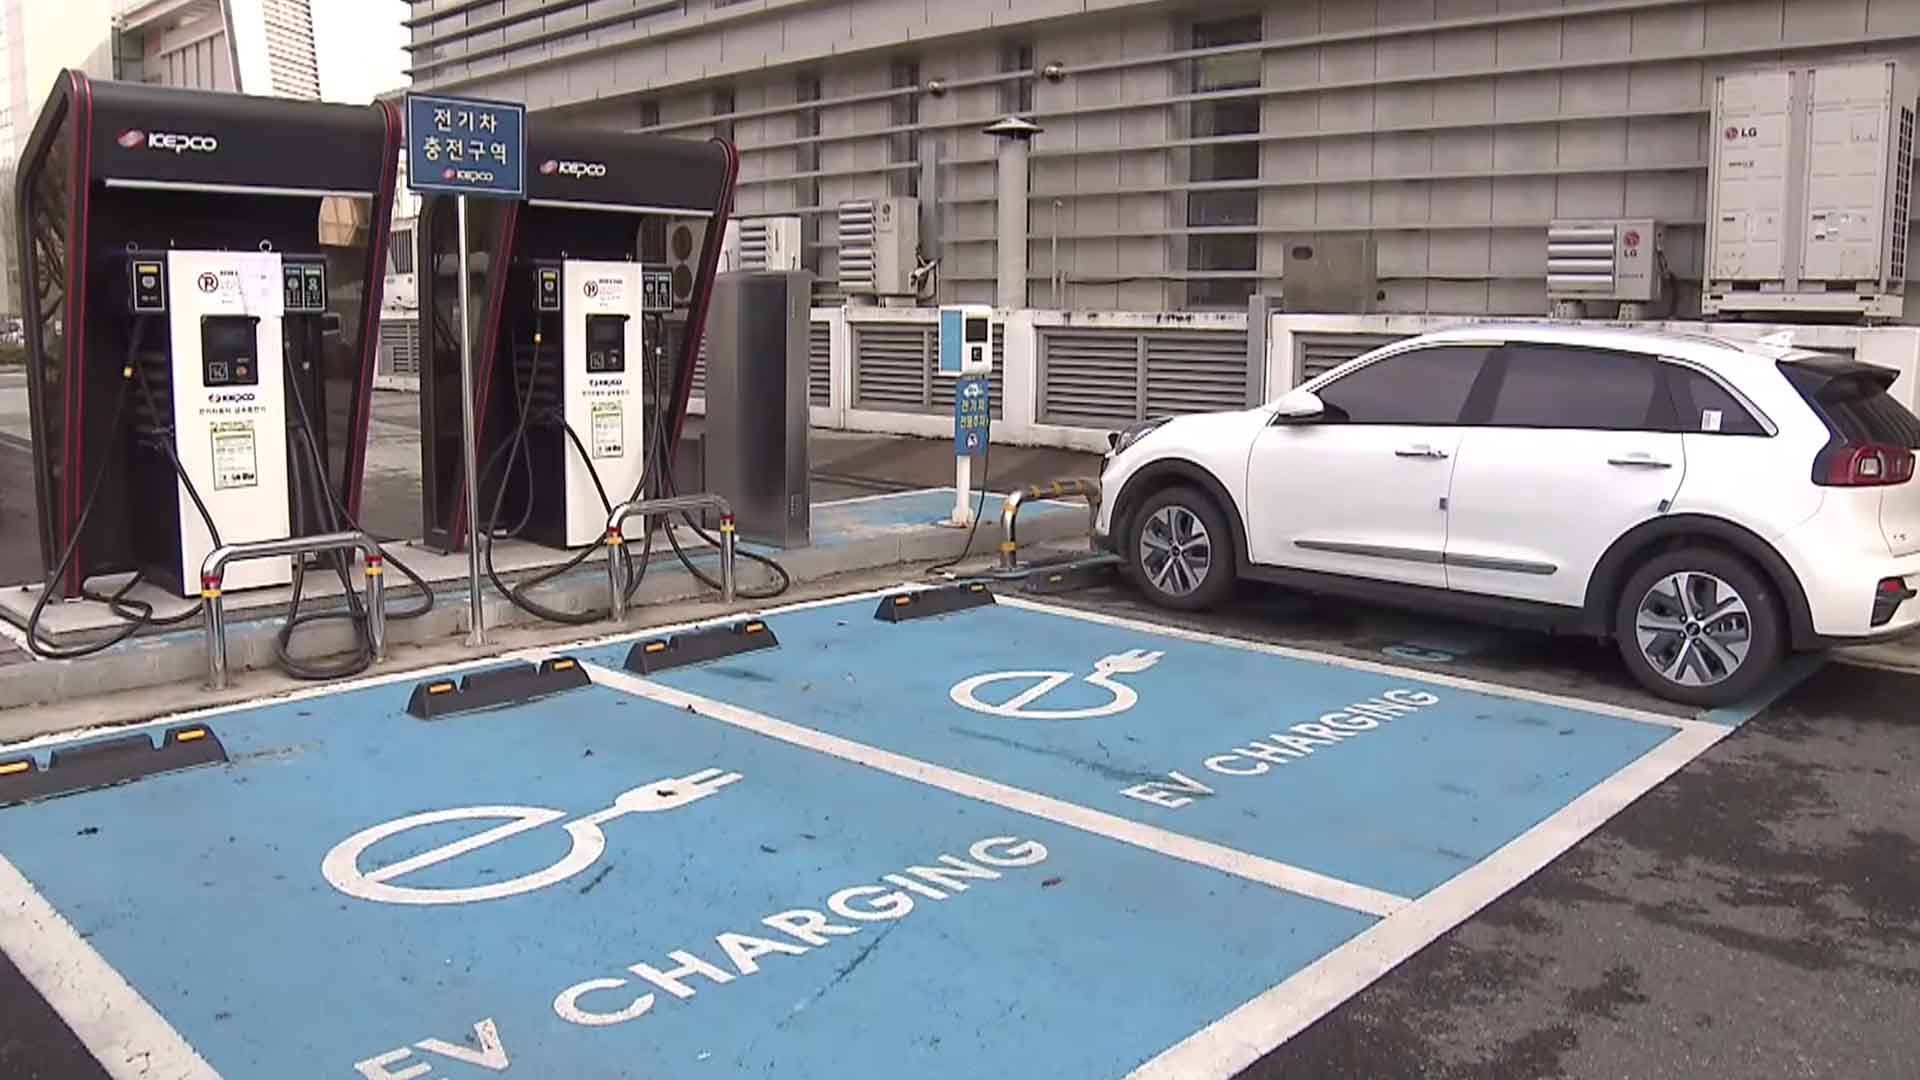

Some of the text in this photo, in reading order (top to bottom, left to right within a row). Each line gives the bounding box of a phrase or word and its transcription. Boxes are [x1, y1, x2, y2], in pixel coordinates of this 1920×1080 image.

[433, 107, 497, 134] 전기차
[1740, 127, 1758, 137] LG
[148, 132, 217, 153] KEPCO
[423, 136, 507, 165] 충전구역
[1623, 249, 1638, 258] LG
[1119, 687, 1441, 809] EV CHARGING
[353, 834, 1049, 1080] EV CHARGING
